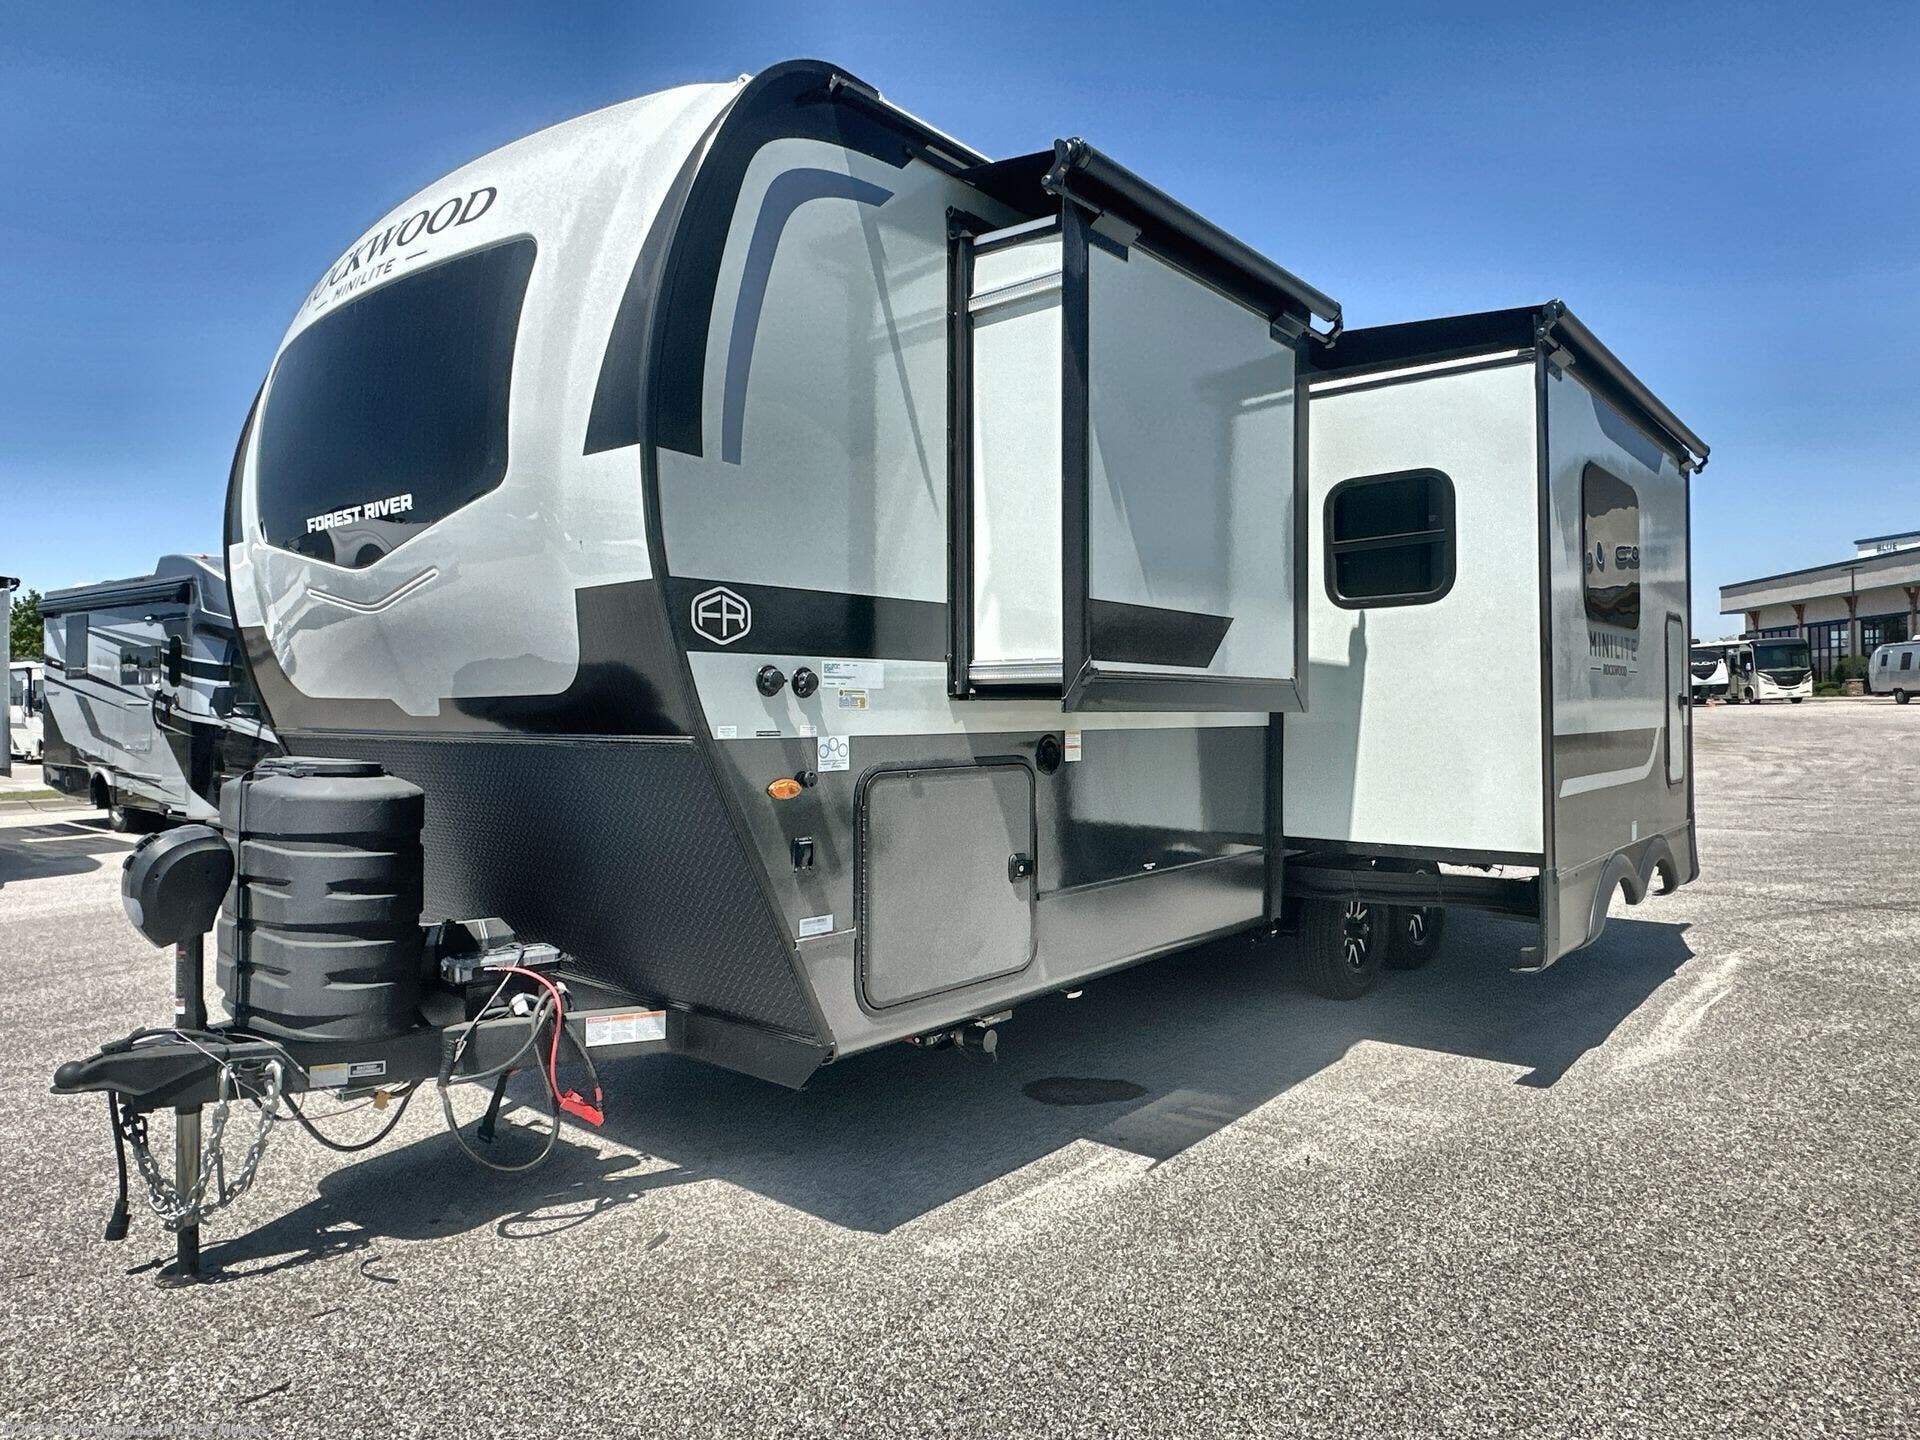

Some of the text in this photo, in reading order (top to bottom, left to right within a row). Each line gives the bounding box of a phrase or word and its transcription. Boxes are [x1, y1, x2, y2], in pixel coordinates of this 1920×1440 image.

[333, 258, 396, 301] MINILITE
[306, 493, 414, 534] FOREST RIVER
[1589, 630, 1638, 662] MINILITE
